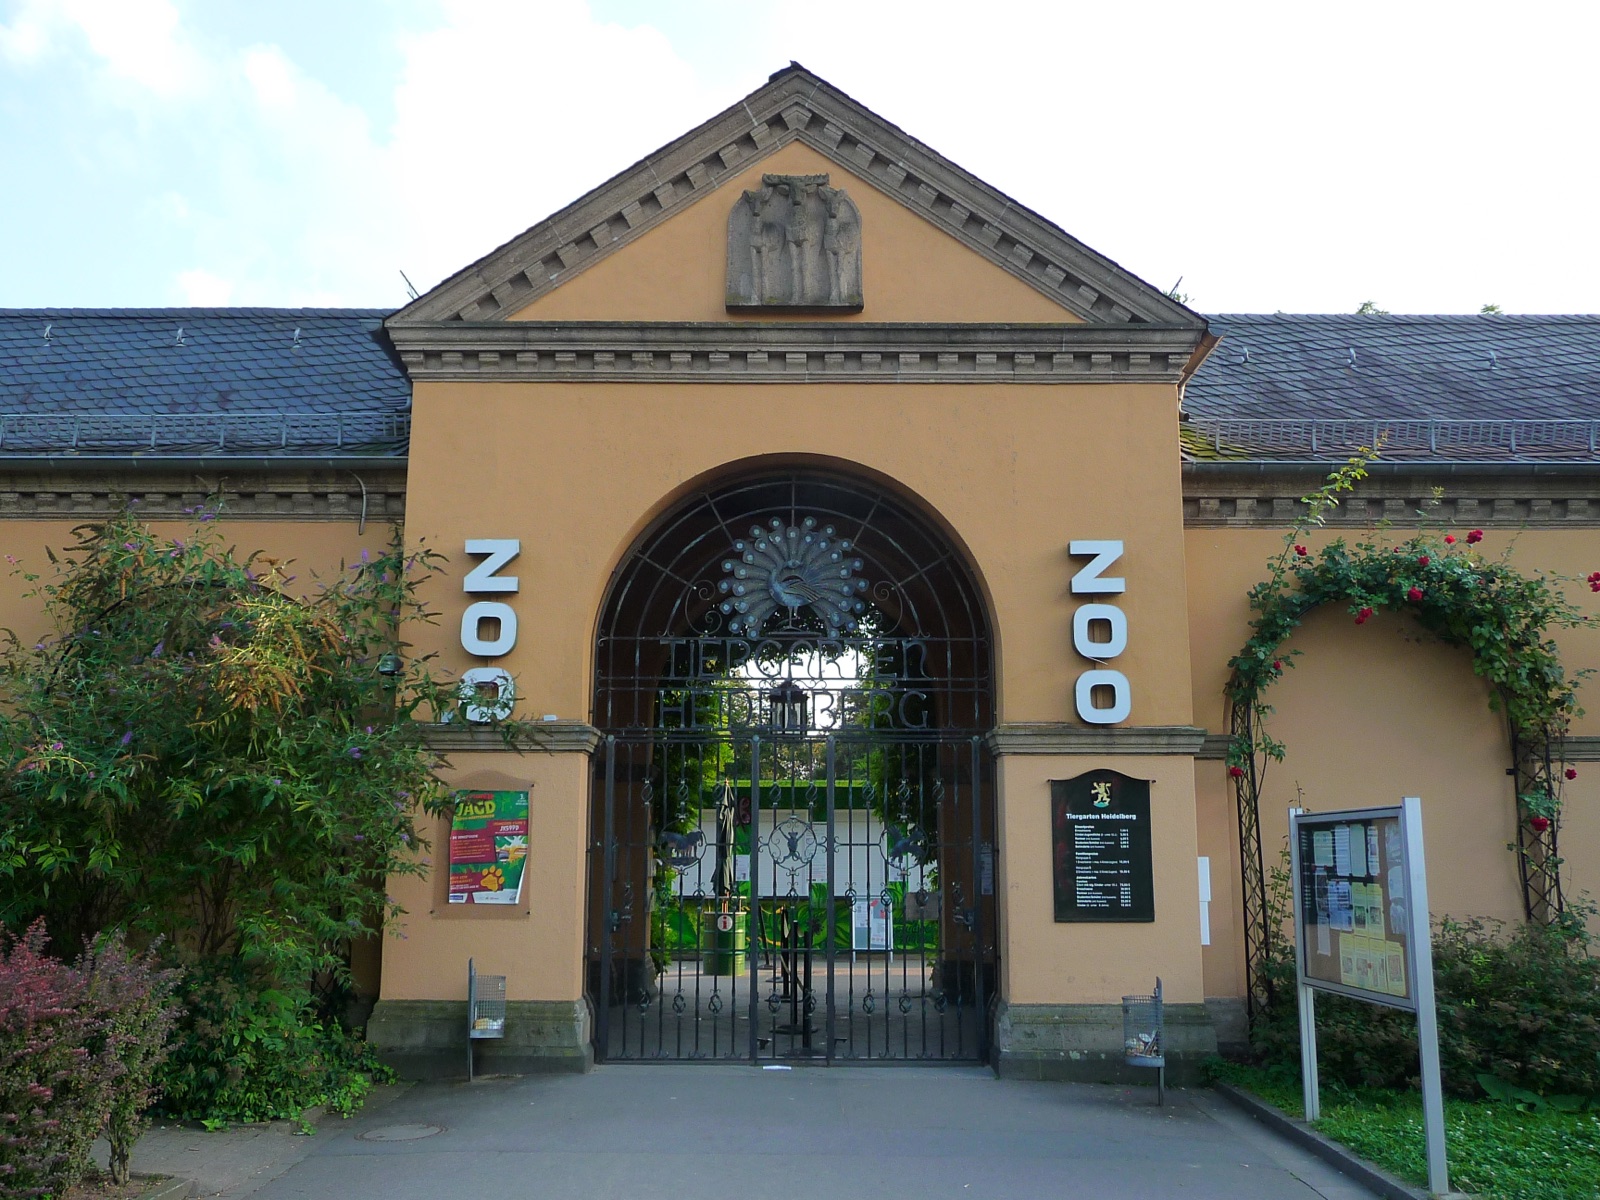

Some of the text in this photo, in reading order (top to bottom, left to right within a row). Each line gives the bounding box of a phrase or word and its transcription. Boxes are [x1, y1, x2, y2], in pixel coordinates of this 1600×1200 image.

[457, 539, 520, 723] ZOO
[660, 638, 932, 679] TIERGARTEN
[1069, 540, 1131, 724] ZOO
